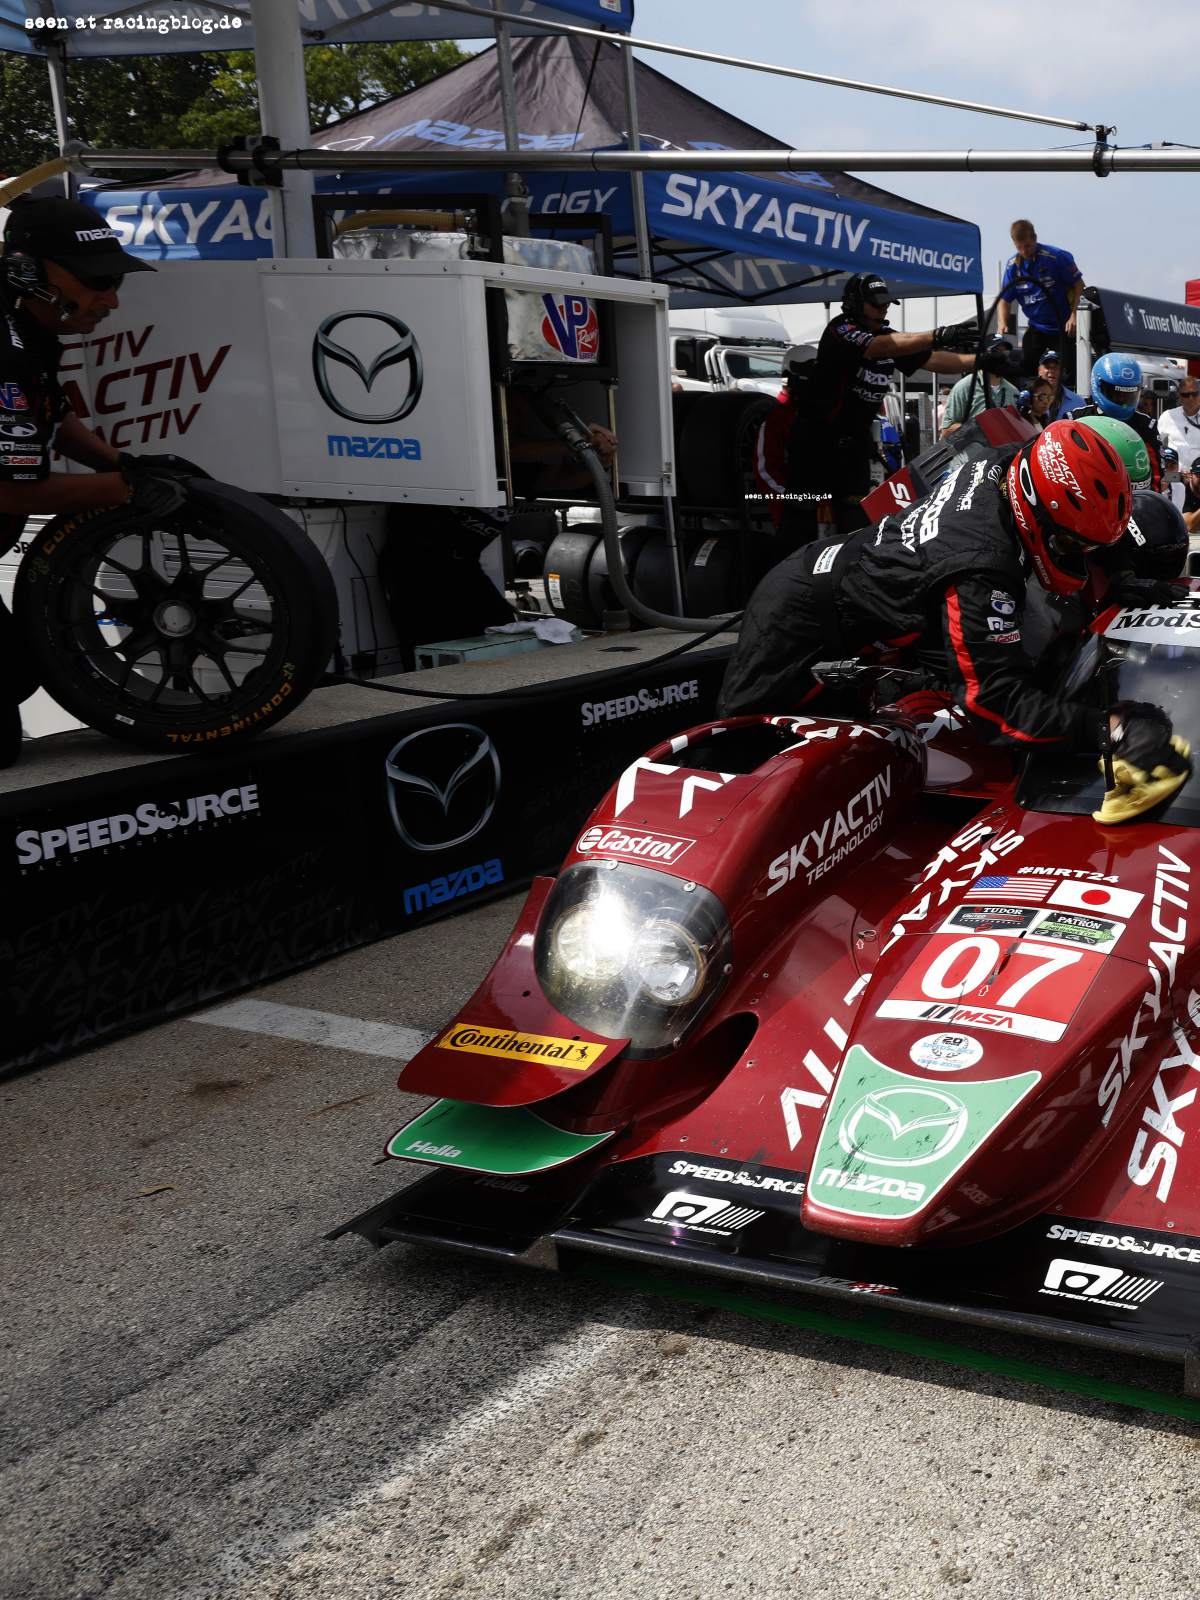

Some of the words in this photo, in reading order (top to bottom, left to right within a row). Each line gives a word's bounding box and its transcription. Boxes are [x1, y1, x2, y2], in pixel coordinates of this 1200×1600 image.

[661, 173, 871, 252] SKYACTIV
[870, 237, 974, 273] TECHNOLOGY
[541, 292, 589, 358] VP
[1139, 308, 1170, 332] Turner
[327, 434, 422, 460] mazda
[1053, 441, 1088, 500] SKYACTIV
[1009, 464, 1030, 530] SKYACTIV
[164, 682, 295, 744] CONTINENTAL
[15, 783, 260, 865] SPEEDSOURCE
[766, 764, 892, 897] SKYACTIV
[600, 829, 684, 860] Castrol
[806, 809, 884, 886] TECHNOLOGY
[403, 858, 504, 914] mazda
[1016, 866, 1121, 884] #MRT24
[983, 907, 1024, 915] TUDOR
[1057, 915, 1103, 929] PATRÓN
[921, 936, 1085, 1008] 07
[1097, 844, 1192, 1129] SKYACTIV
[952, 1009, 1014, 1029] IMSA
[450, 1028, 574, 1060] Continental
[942, 1036, 964, 1045] 20
[405, 1140, 462, 1158] Hella
[668, 1160, 806, 1195] SPEEDSOURCE
[816, 1168, 926, 1201] mazda
[686, 1224, 733, 1236] RACING
[1038, 1287, 1087, 1301] MOTEGI
[1087, 1296, 1139, 1310] RACING
